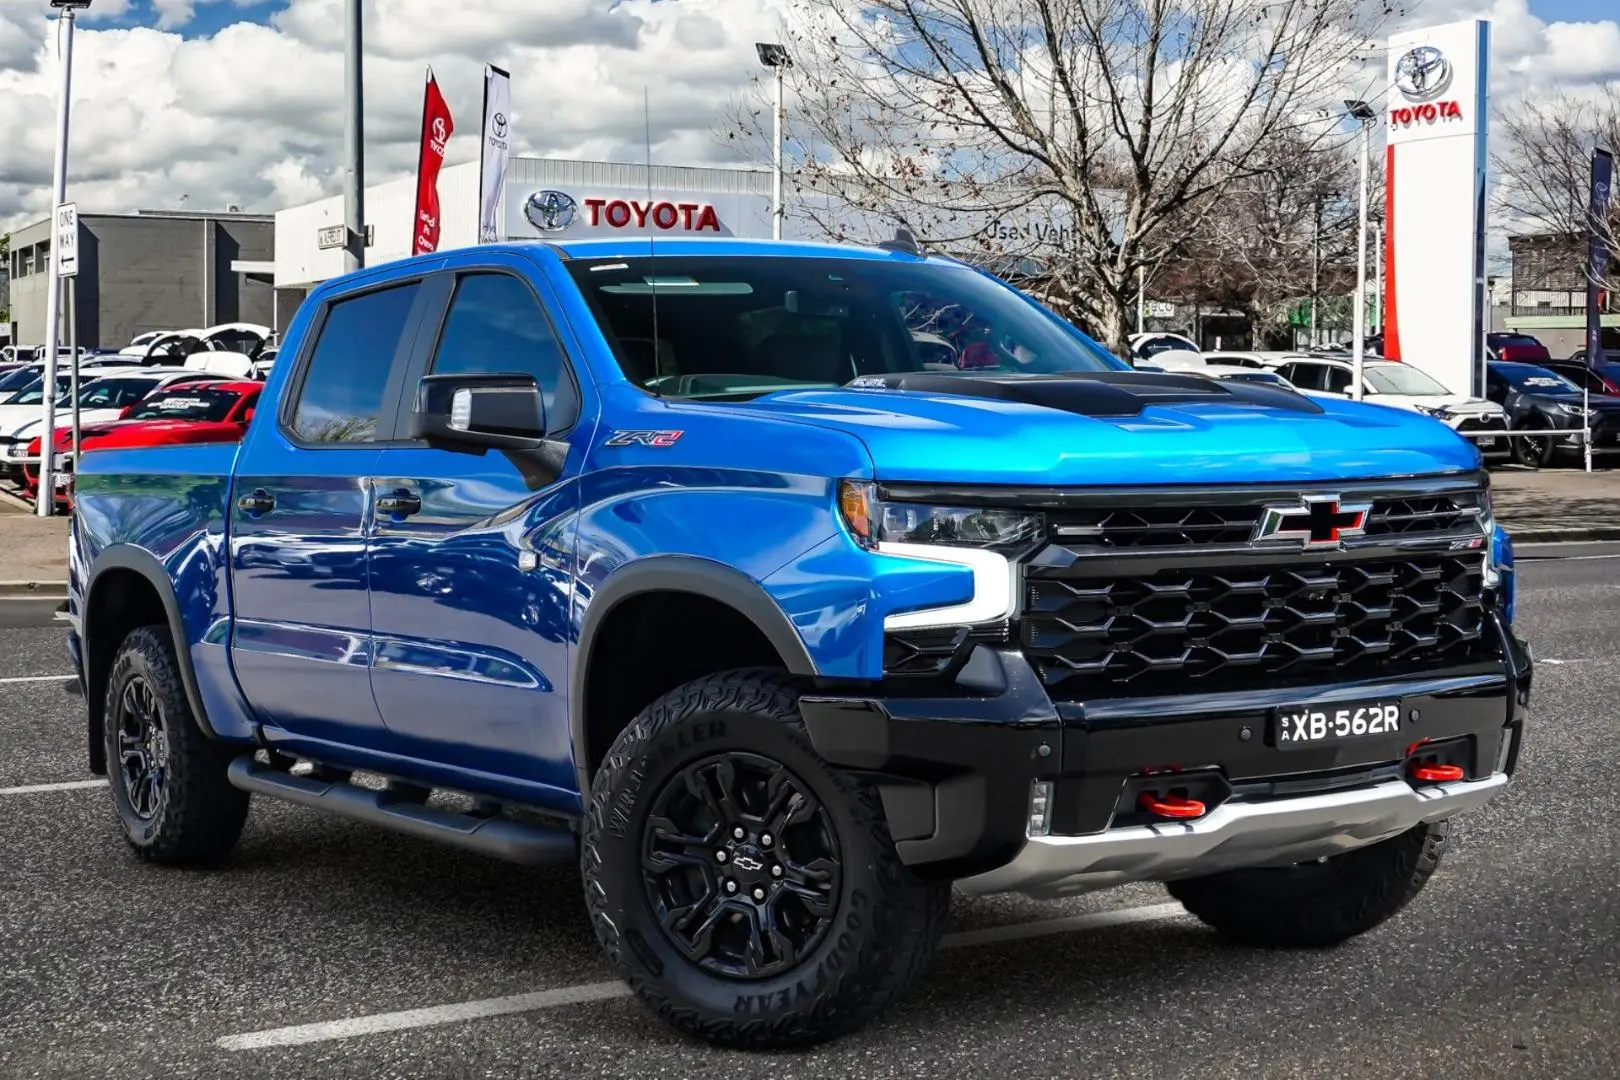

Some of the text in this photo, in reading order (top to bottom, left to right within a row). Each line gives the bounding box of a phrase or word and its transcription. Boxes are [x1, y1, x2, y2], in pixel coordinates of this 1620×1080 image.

[1389, 101, 1461, 124] TOYOTA
[60, 209, 74, 228] ONE
[584, 198, 721, 232] TOYOTA
[59, 231, 75, 248] WAY
[604, 429, 685, 446] ZR2
